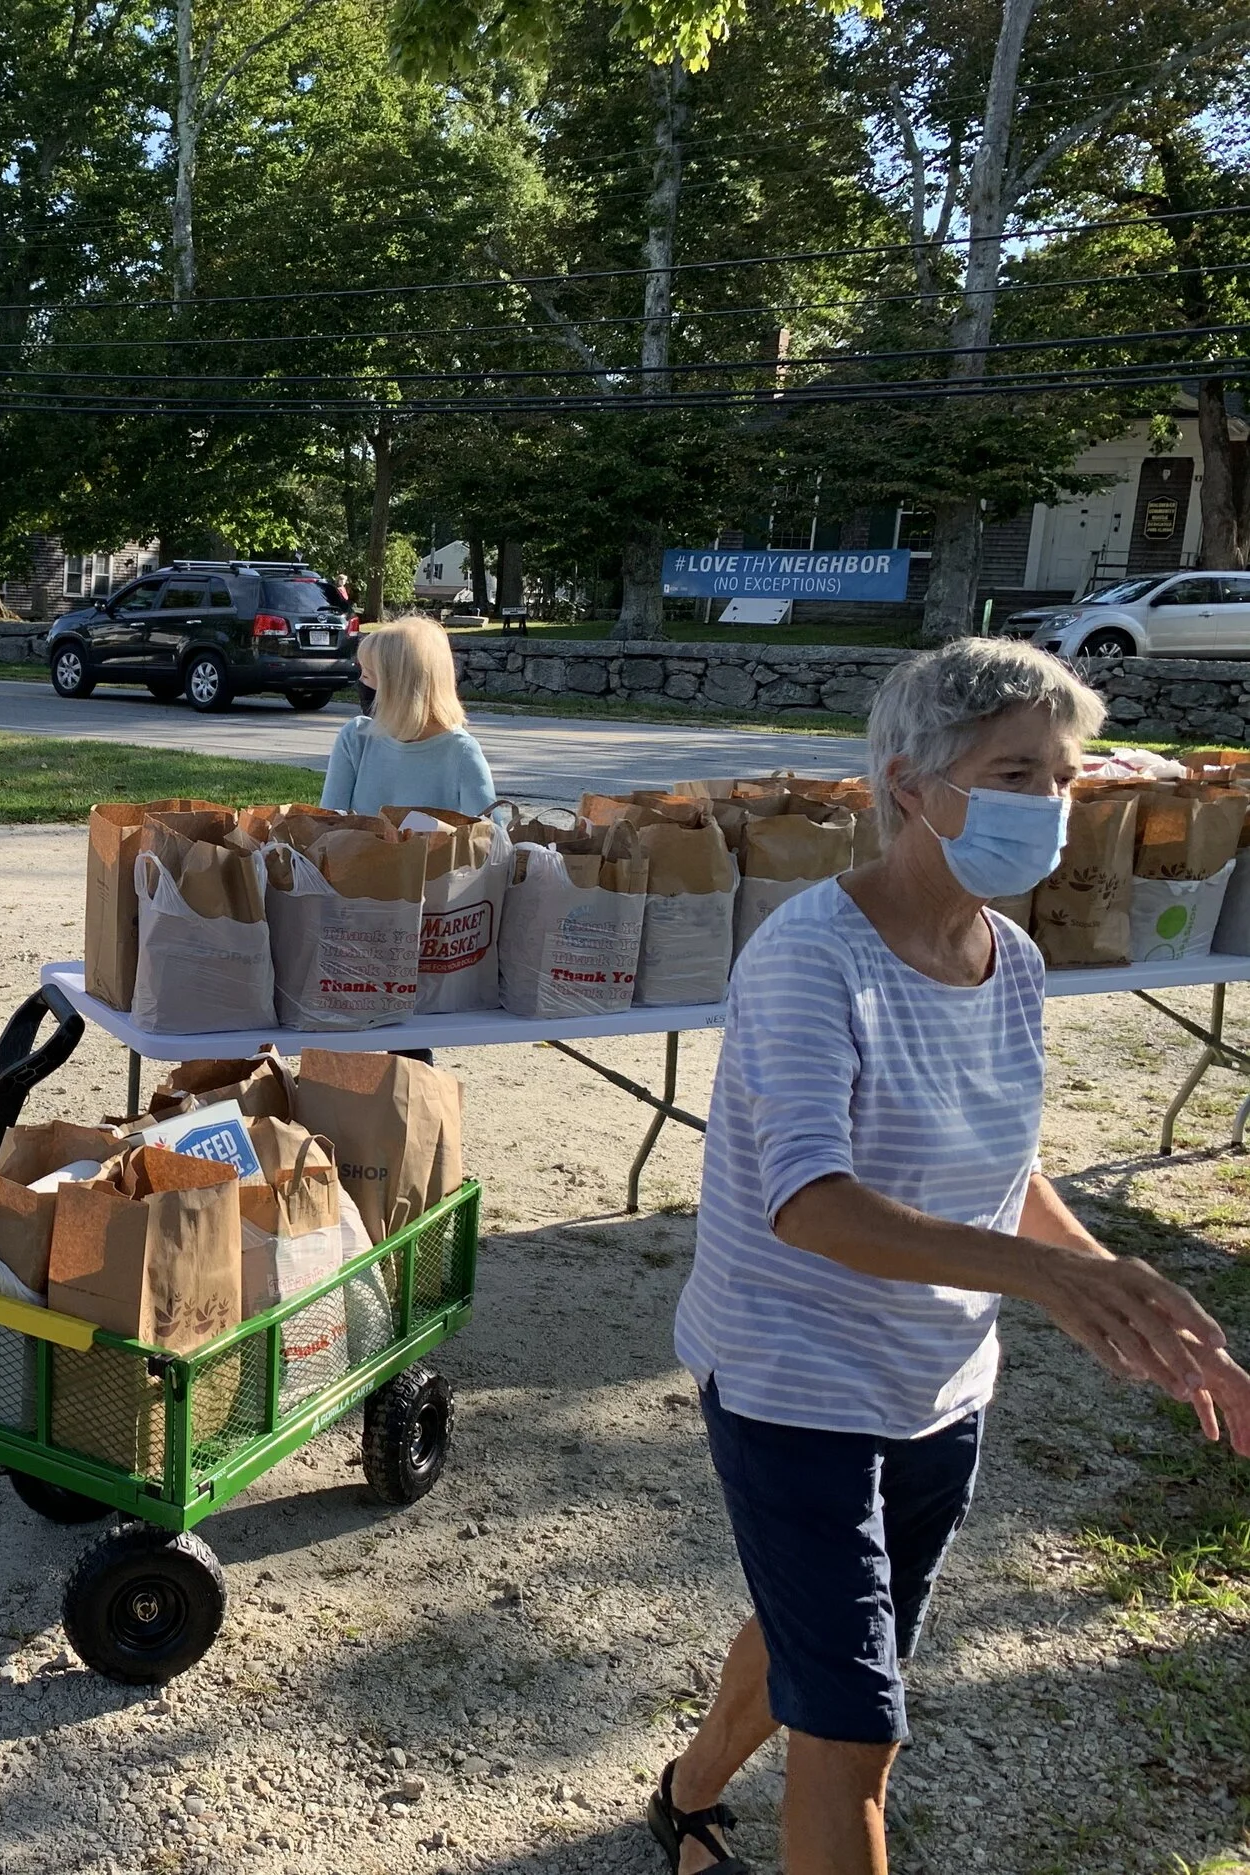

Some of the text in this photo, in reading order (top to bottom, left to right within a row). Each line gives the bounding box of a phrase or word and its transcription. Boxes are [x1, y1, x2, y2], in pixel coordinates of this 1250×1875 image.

[713, 577, 842, 594] (NO EXCEPTIONS)
[420, 910, 486, 938] MARKET
[622, 921, 642, 935] Yo
[393, 929, 419, 944] Yo
[419, 932, 481, 958] BASKET
[619, 938, 639, 951] Yo
[616, 954, 636, 968] Yo
[551, 968, 635, 984] Thank Yo
[319, 979, 417, 994] Thank You
[609, 986, 632, 1000] Yo
[705, 1014, 726, 1025] WES
[340, 1163, 389, 1181] SHOP
[320, 1378, 376, 1426] GORILLA CARTS
